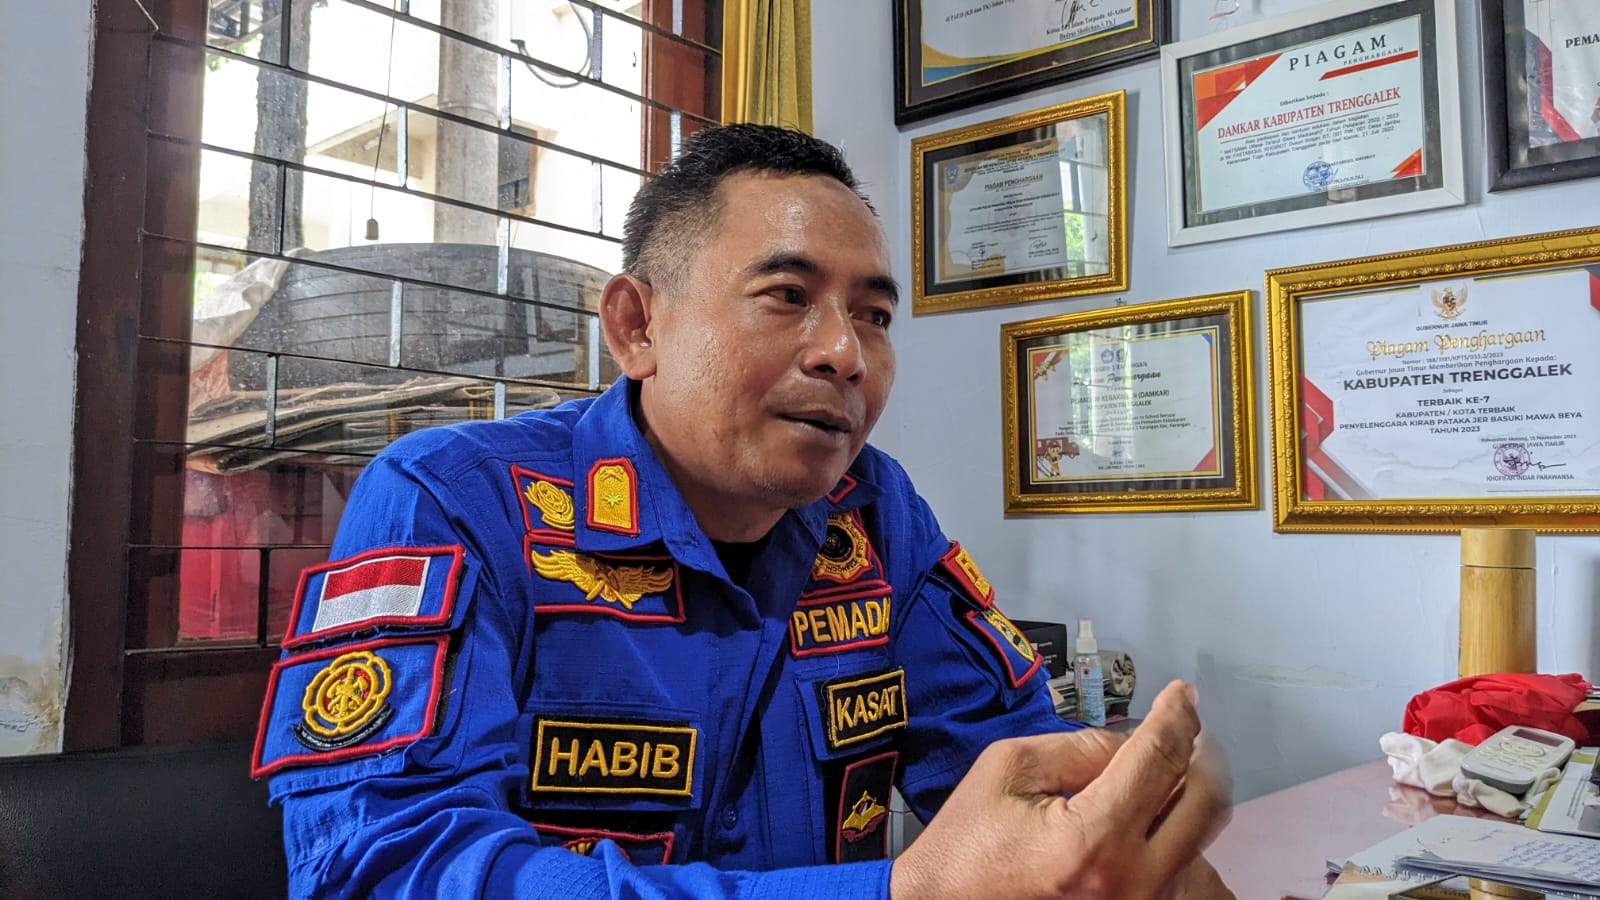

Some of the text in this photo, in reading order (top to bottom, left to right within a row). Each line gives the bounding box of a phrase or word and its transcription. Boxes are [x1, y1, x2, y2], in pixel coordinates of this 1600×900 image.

[1565, 33, 1600, 49] PEMA
[1288, 34, 1388, 71] PIAGAM
[1343, 47, 1405, 66] PENGHARGAAN
[1217, 87, 1400, 139] DAMKAR KABUPATEN TRENGGALEK
[1416, 319, 1488, 332] GUBERNUR JAWA TIMUR
[1366, 328, 1546, 361] Piagam Penghargaan
[1355, 354, 1557, 376] Gubernur Jawa Timur Memberikan Penghargaan Kepada:
[1343, 363, 1573, 391] KABUPATEN TRENGGALEK
[1138, 390, 1169, 399] (DAMKAR)
[1416, 395, 1491, 407] TERBAIK KE-7
[1339, 411, 1583, 430] PENYELENGGARA KIRAB PATAKA JER BASUKI MAWA BEYA
[1395, 410, 1446, 419] KABUPATEN
[1452, 407, 1476, 416] KOTA
[1477, 406, 1516, 415] TERBAIK
[1429, 425, 1481, 434] TAHUN 2023
[1536, 473, 1575, 481] PARAWANSA
[836, 685, 899, 731] KASAT
[548, 736, 680, 779] HABIB
